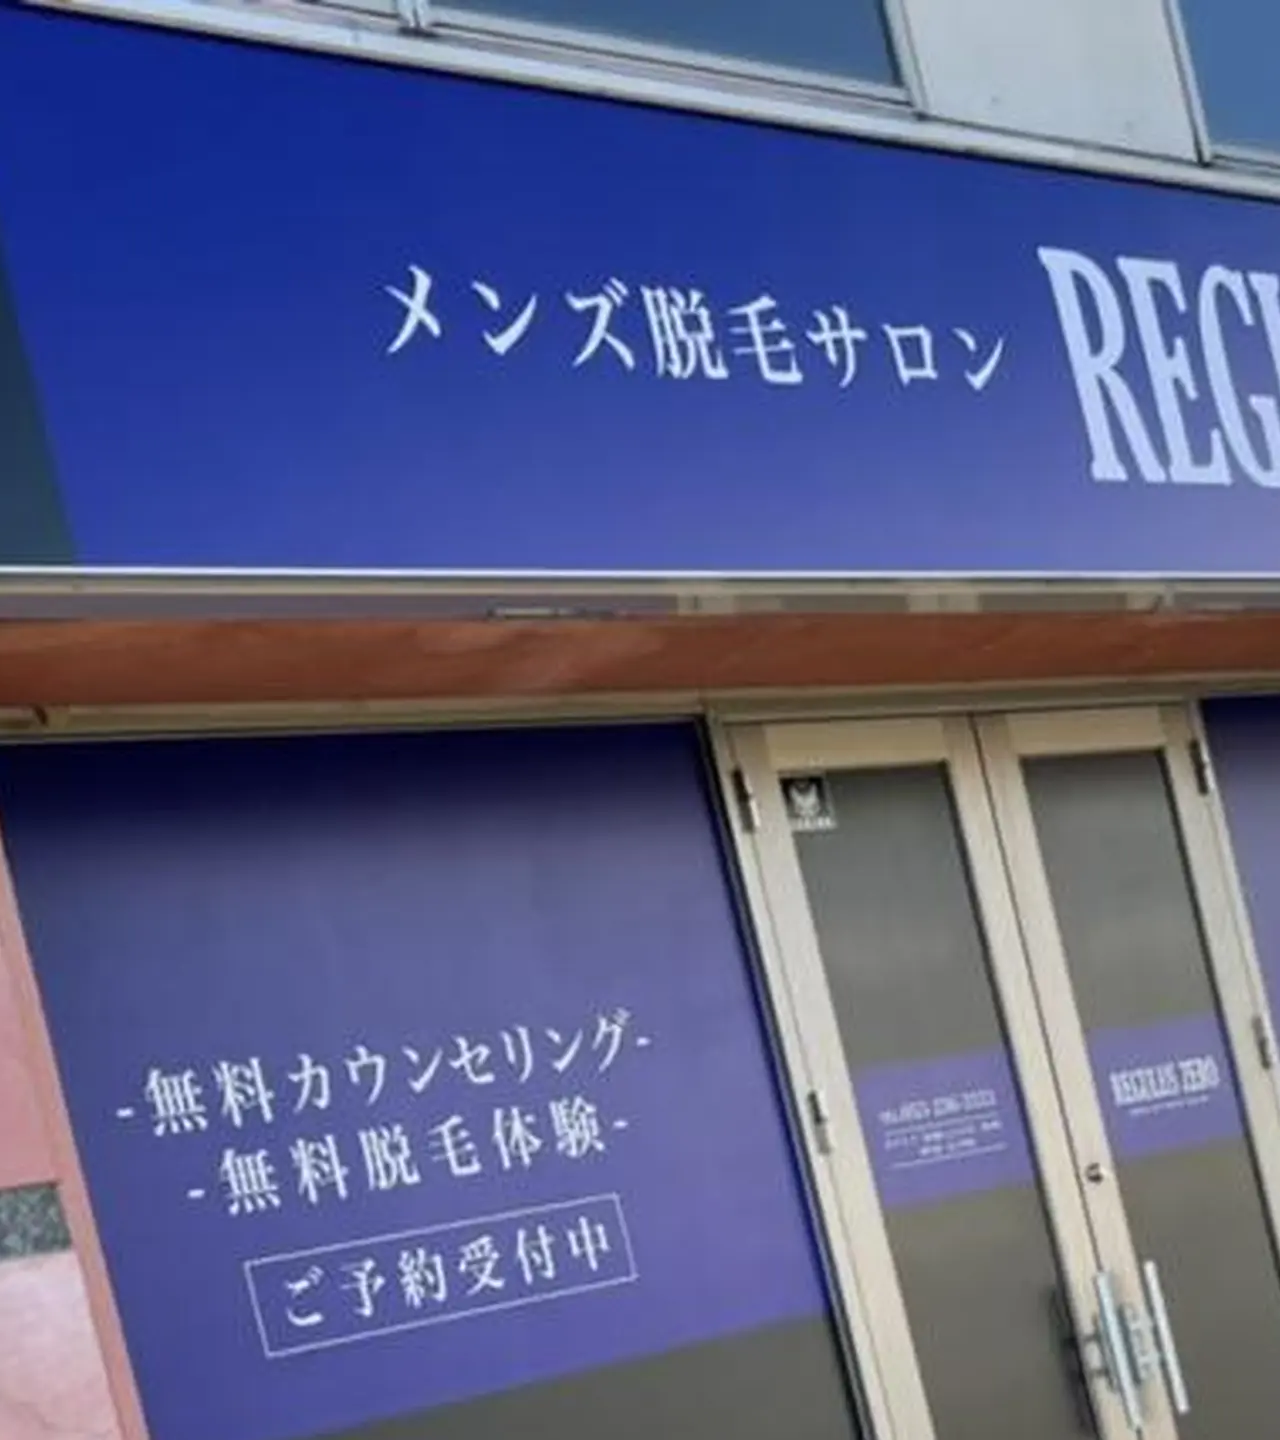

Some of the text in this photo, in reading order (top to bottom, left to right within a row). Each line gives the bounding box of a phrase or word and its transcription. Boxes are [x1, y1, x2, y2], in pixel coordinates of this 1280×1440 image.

[384, 264, 1005, 391] メンズ脱毛サロン
[284, 1215, 610, 1328] ご予約受付中
